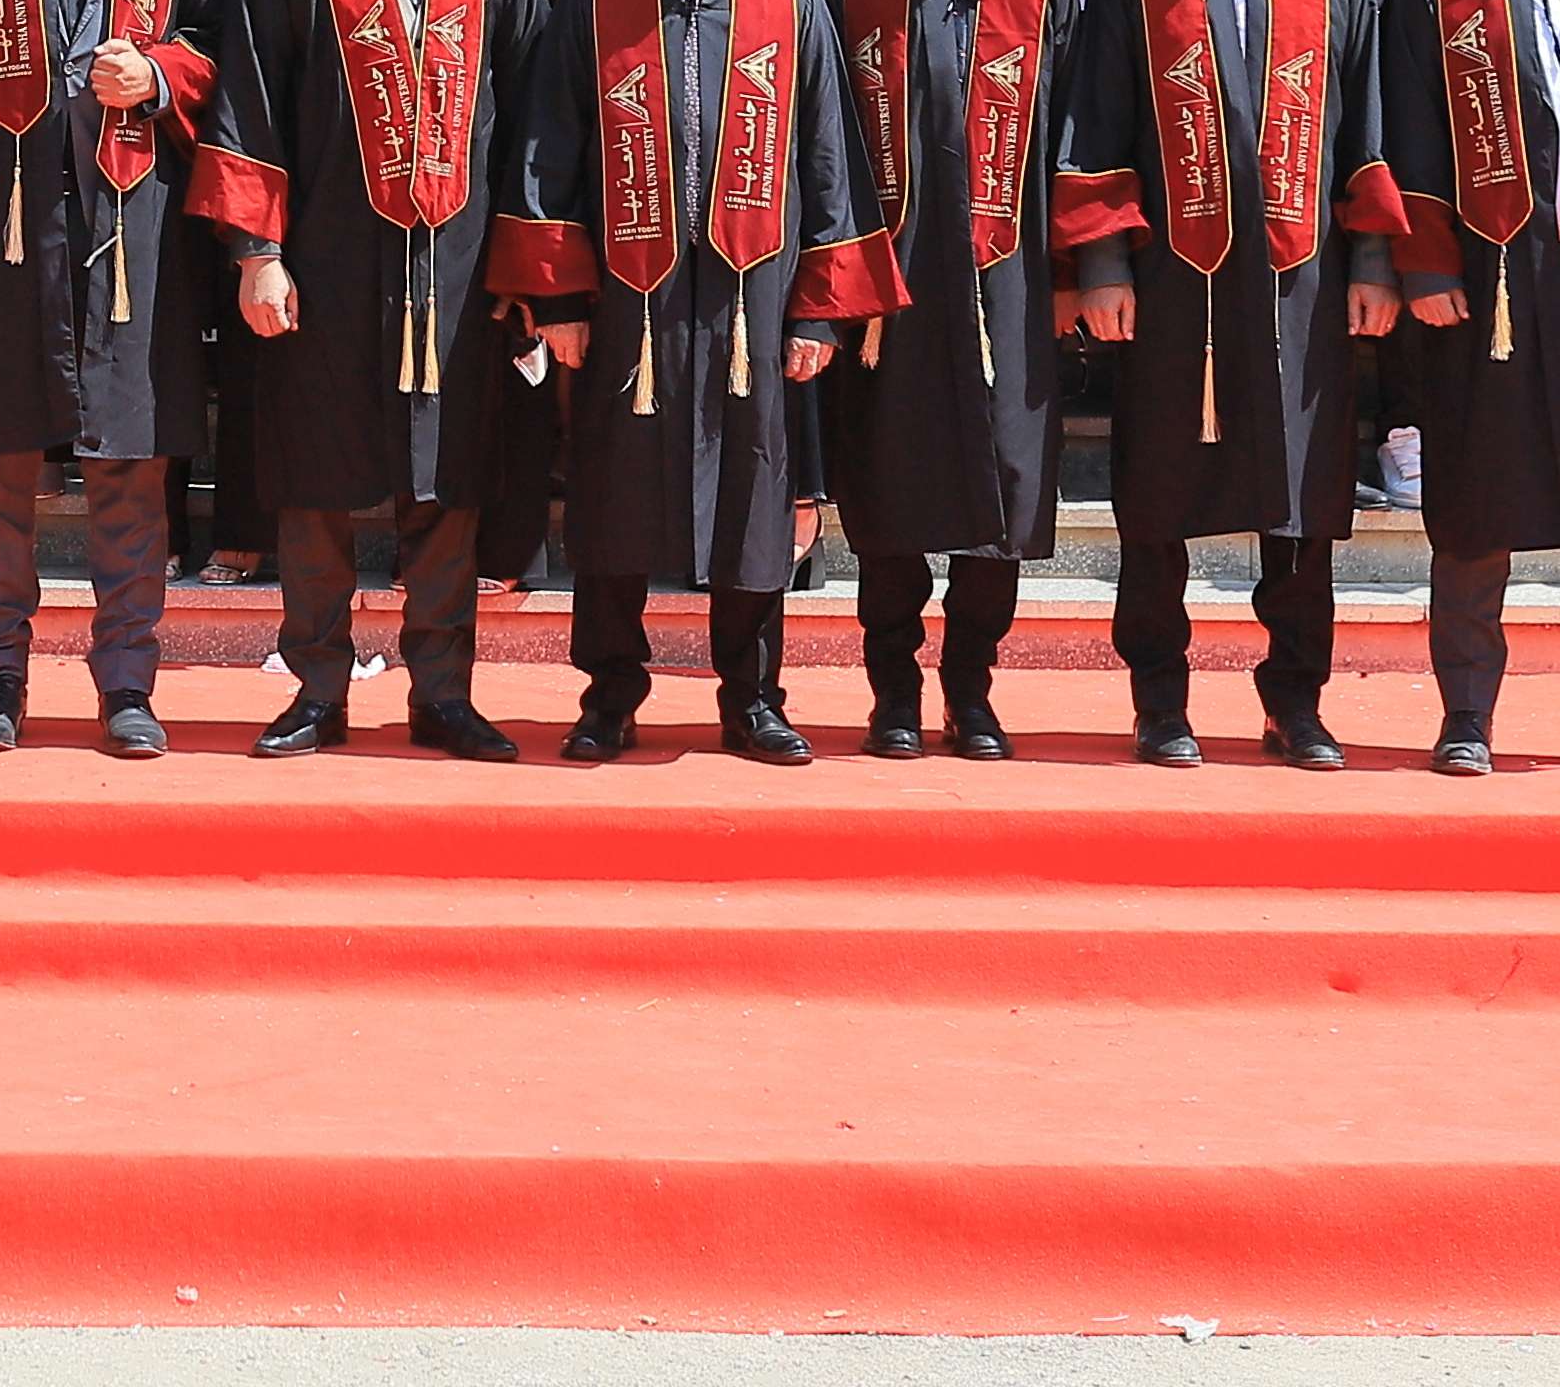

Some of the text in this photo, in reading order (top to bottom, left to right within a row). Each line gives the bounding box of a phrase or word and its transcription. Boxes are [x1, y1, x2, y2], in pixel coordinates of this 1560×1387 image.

[17, 26, 30, 62] BENHA
[393, 62, 416, 123] UNIVERSITY
[453, 68, 468, 127] UNIVERSITY
[877, 89, 892, 150] UNIVERSITY
[1485, 71, 1515, 167] BENHA UNIVERSITY
[761, 103, 778, 201] BENHA UNIVERSITY
[1001, 108, 1020, 204] BENHA UNIVERSITY
[1203, 103, 1220, 164] UNIVERSITY
[1292, 112, 1312, 209] BENHA UNIVERSITY
[643, 126, 661, 225] BENHA UNIVERSITY
[881, 151, 898, 186] BENHA
